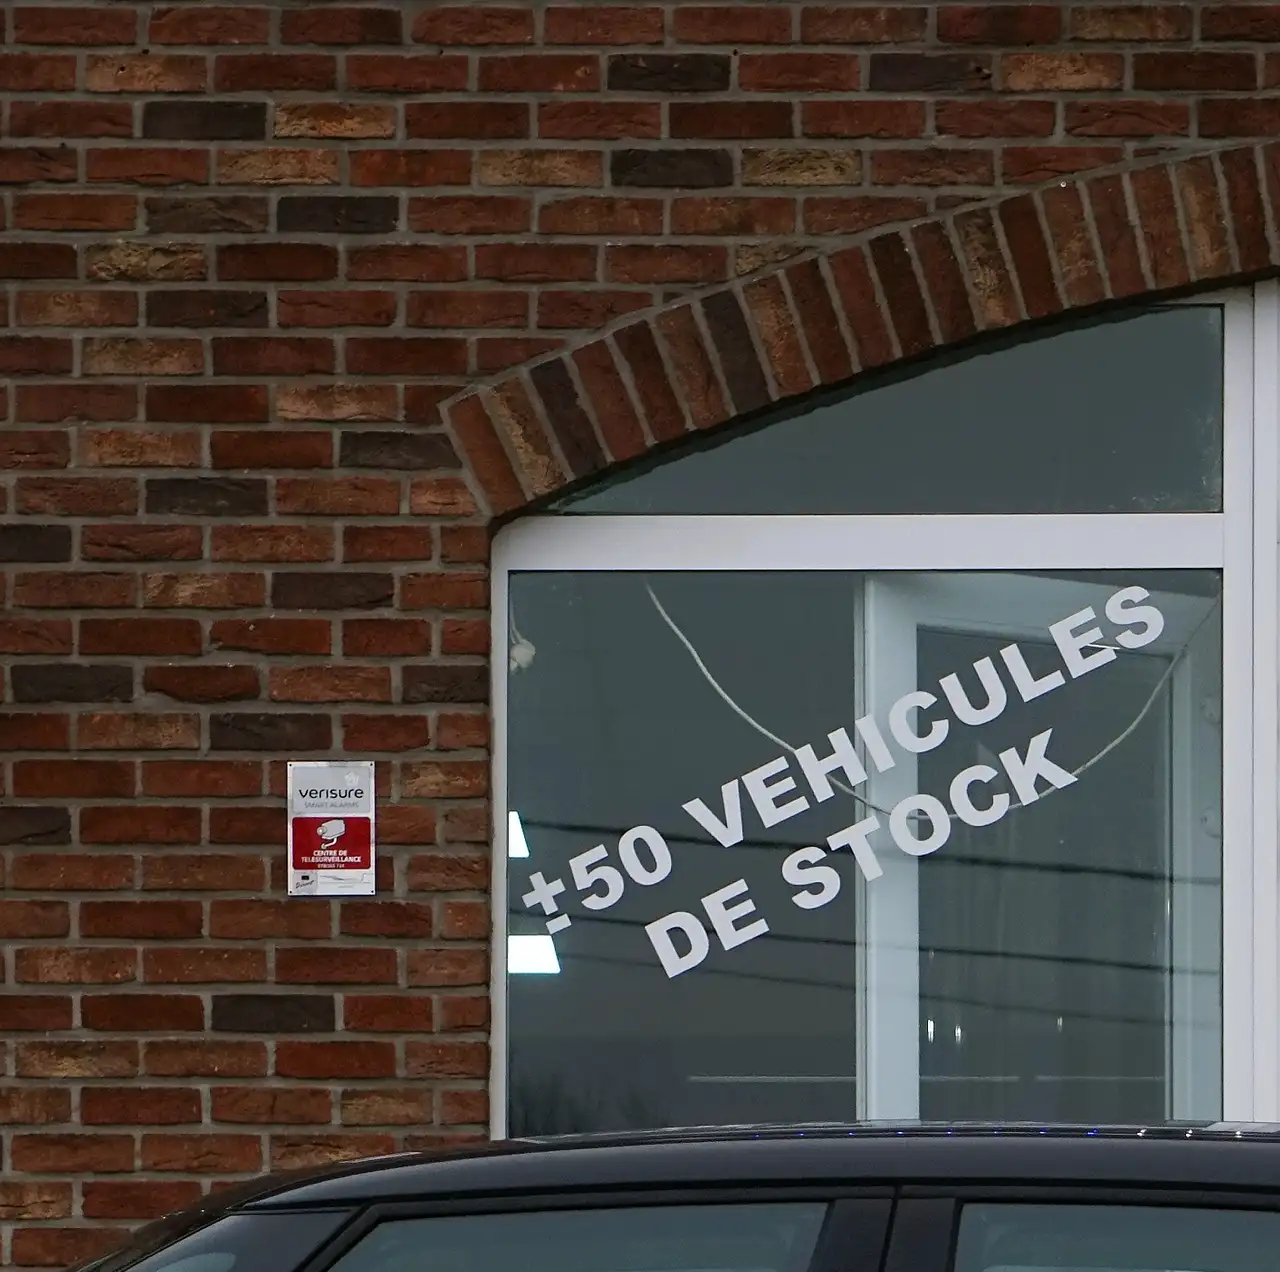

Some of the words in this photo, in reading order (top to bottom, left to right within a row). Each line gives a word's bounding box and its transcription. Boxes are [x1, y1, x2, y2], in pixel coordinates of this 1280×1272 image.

[298, 788, 365, 799] verisure
[682, 585, 1165, 848] VEHICULES
[644, 879, 770, 979] DE
[782, 728, 1079, 910] STOCK
